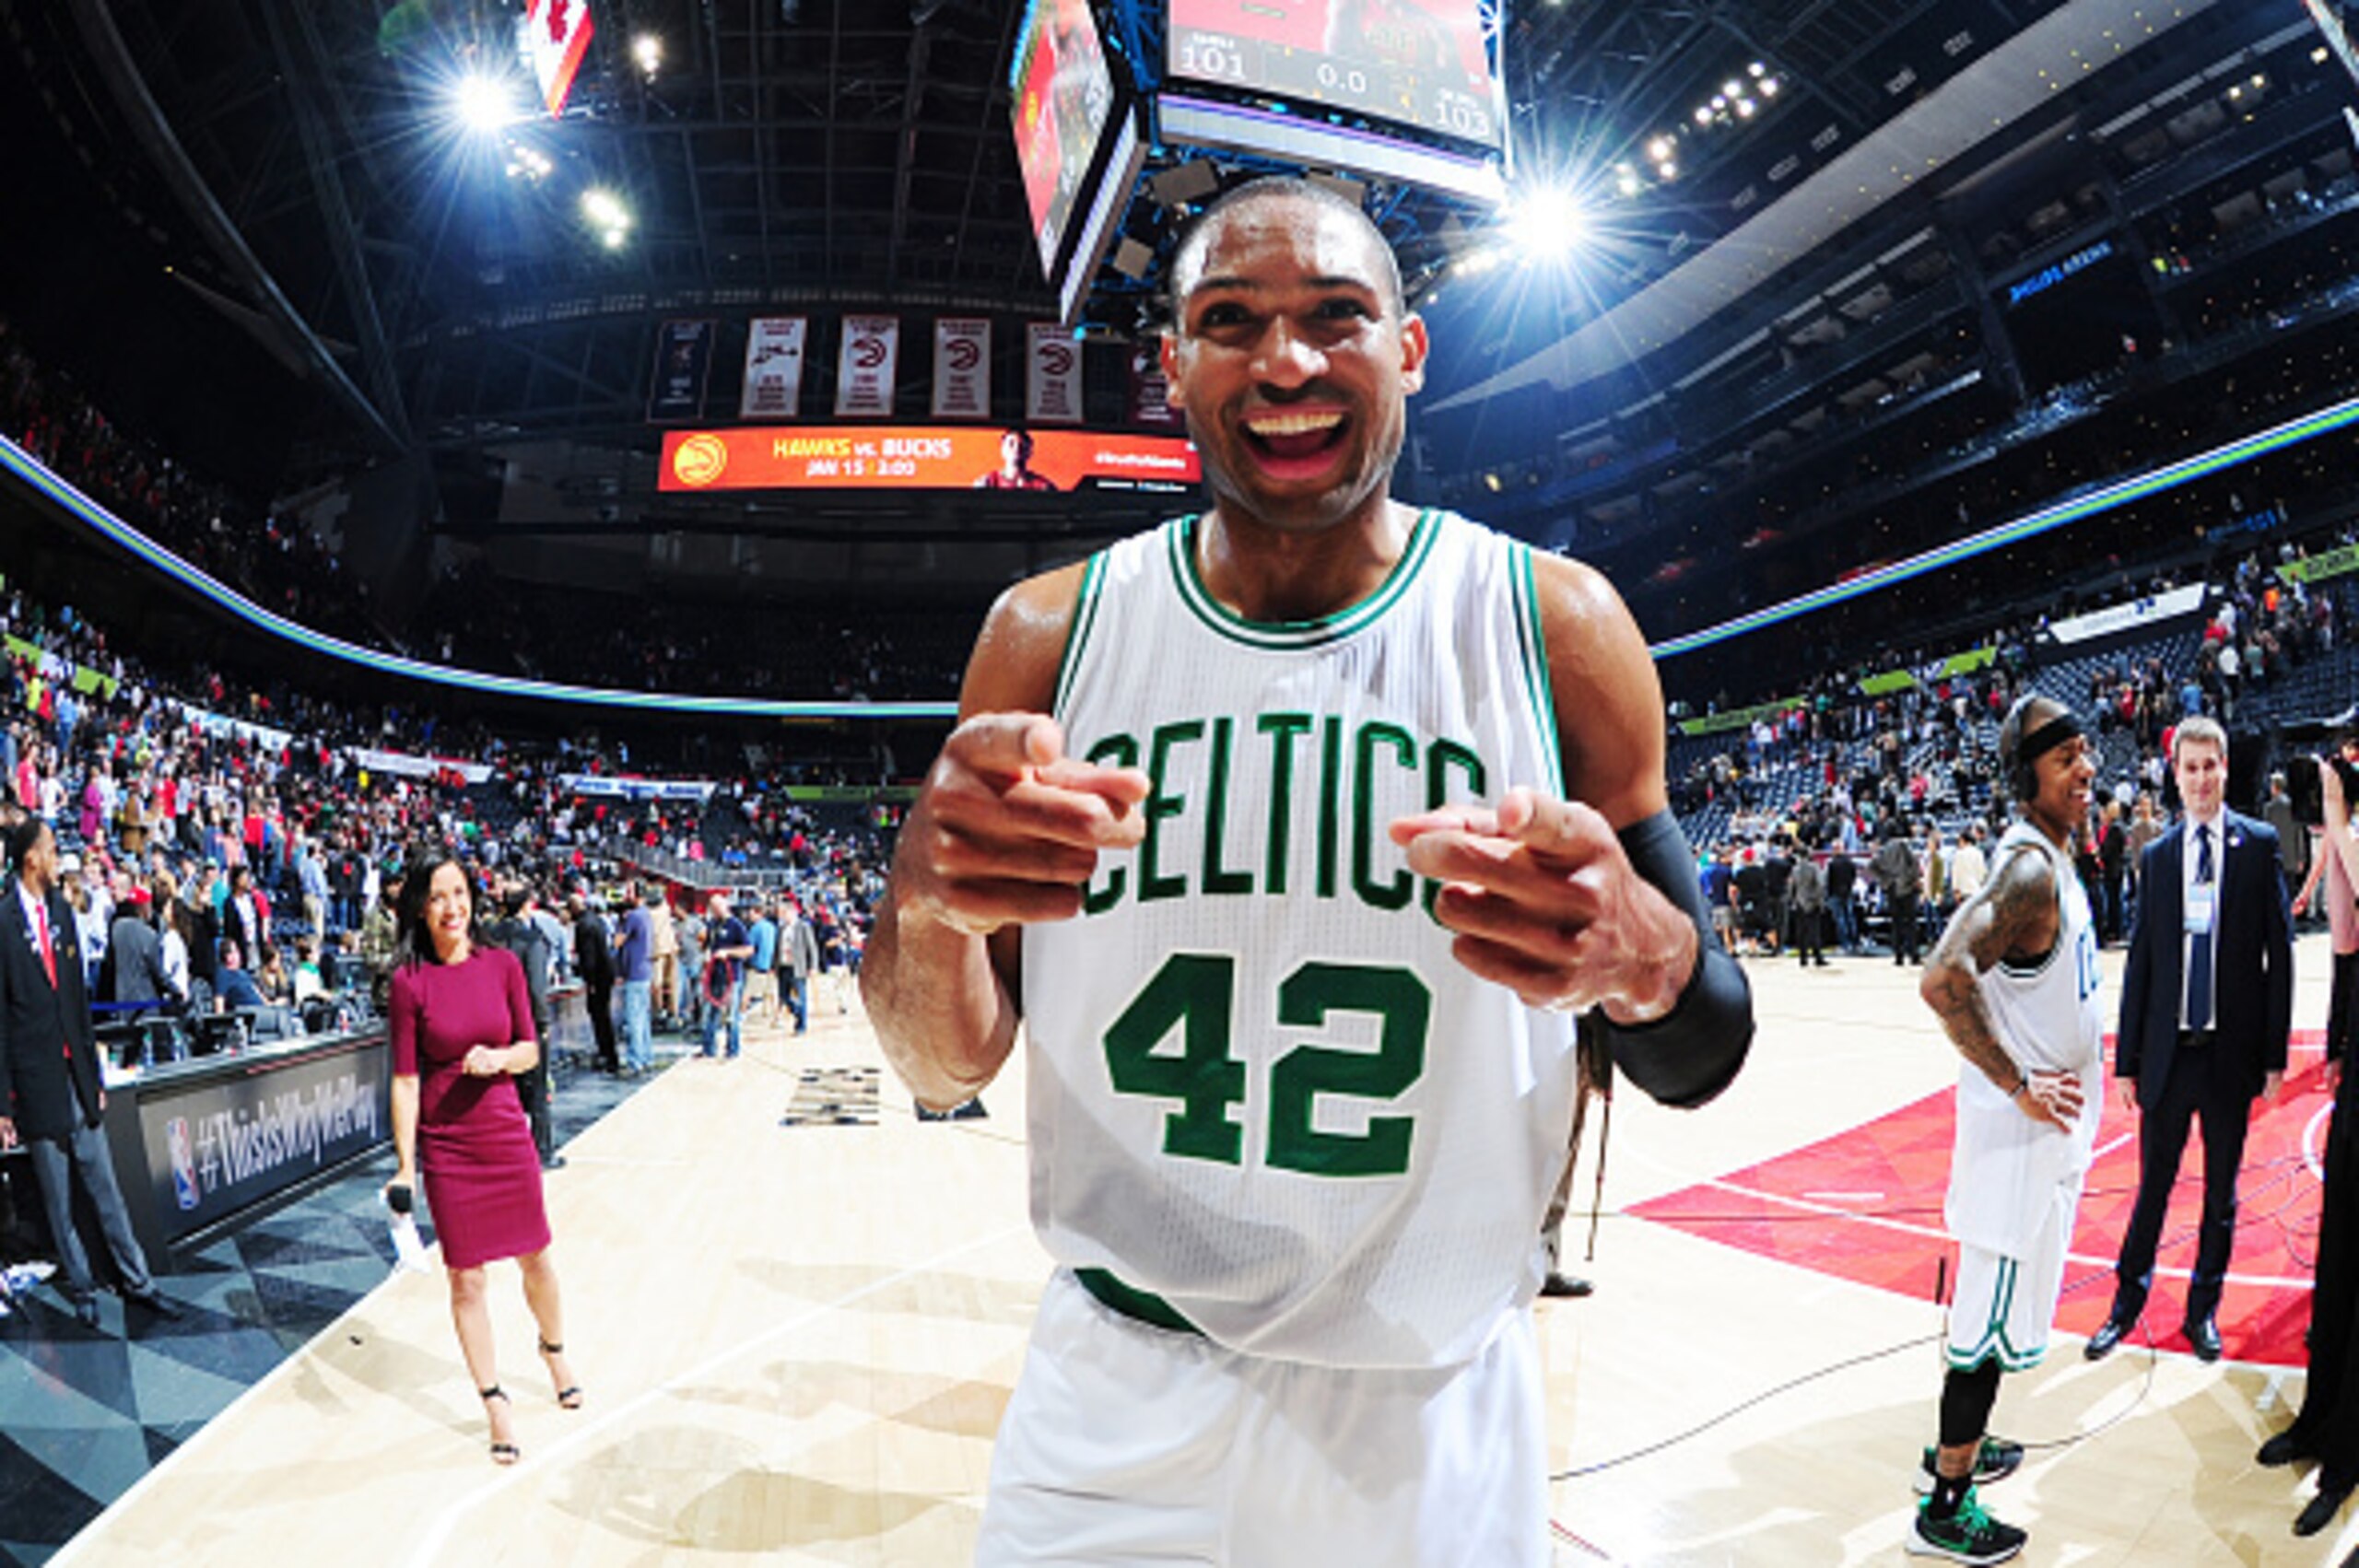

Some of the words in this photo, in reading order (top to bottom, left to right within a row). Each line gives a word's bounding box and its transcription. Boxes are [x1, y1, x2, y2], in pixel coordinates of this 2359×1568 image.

[1180, 47, 1246, 80] 101
[1316, 63, 1367, 93] 0.0
[1435, 101, 1490, 137] 103
[773, 439, 851, 458] HAWKS
[882, 439, 952, 458] BUCKS
[805, 460, 839, 477] JAN
[842, 460, 864, 476] 15
[1101, 952, 1432, 1177] 42
